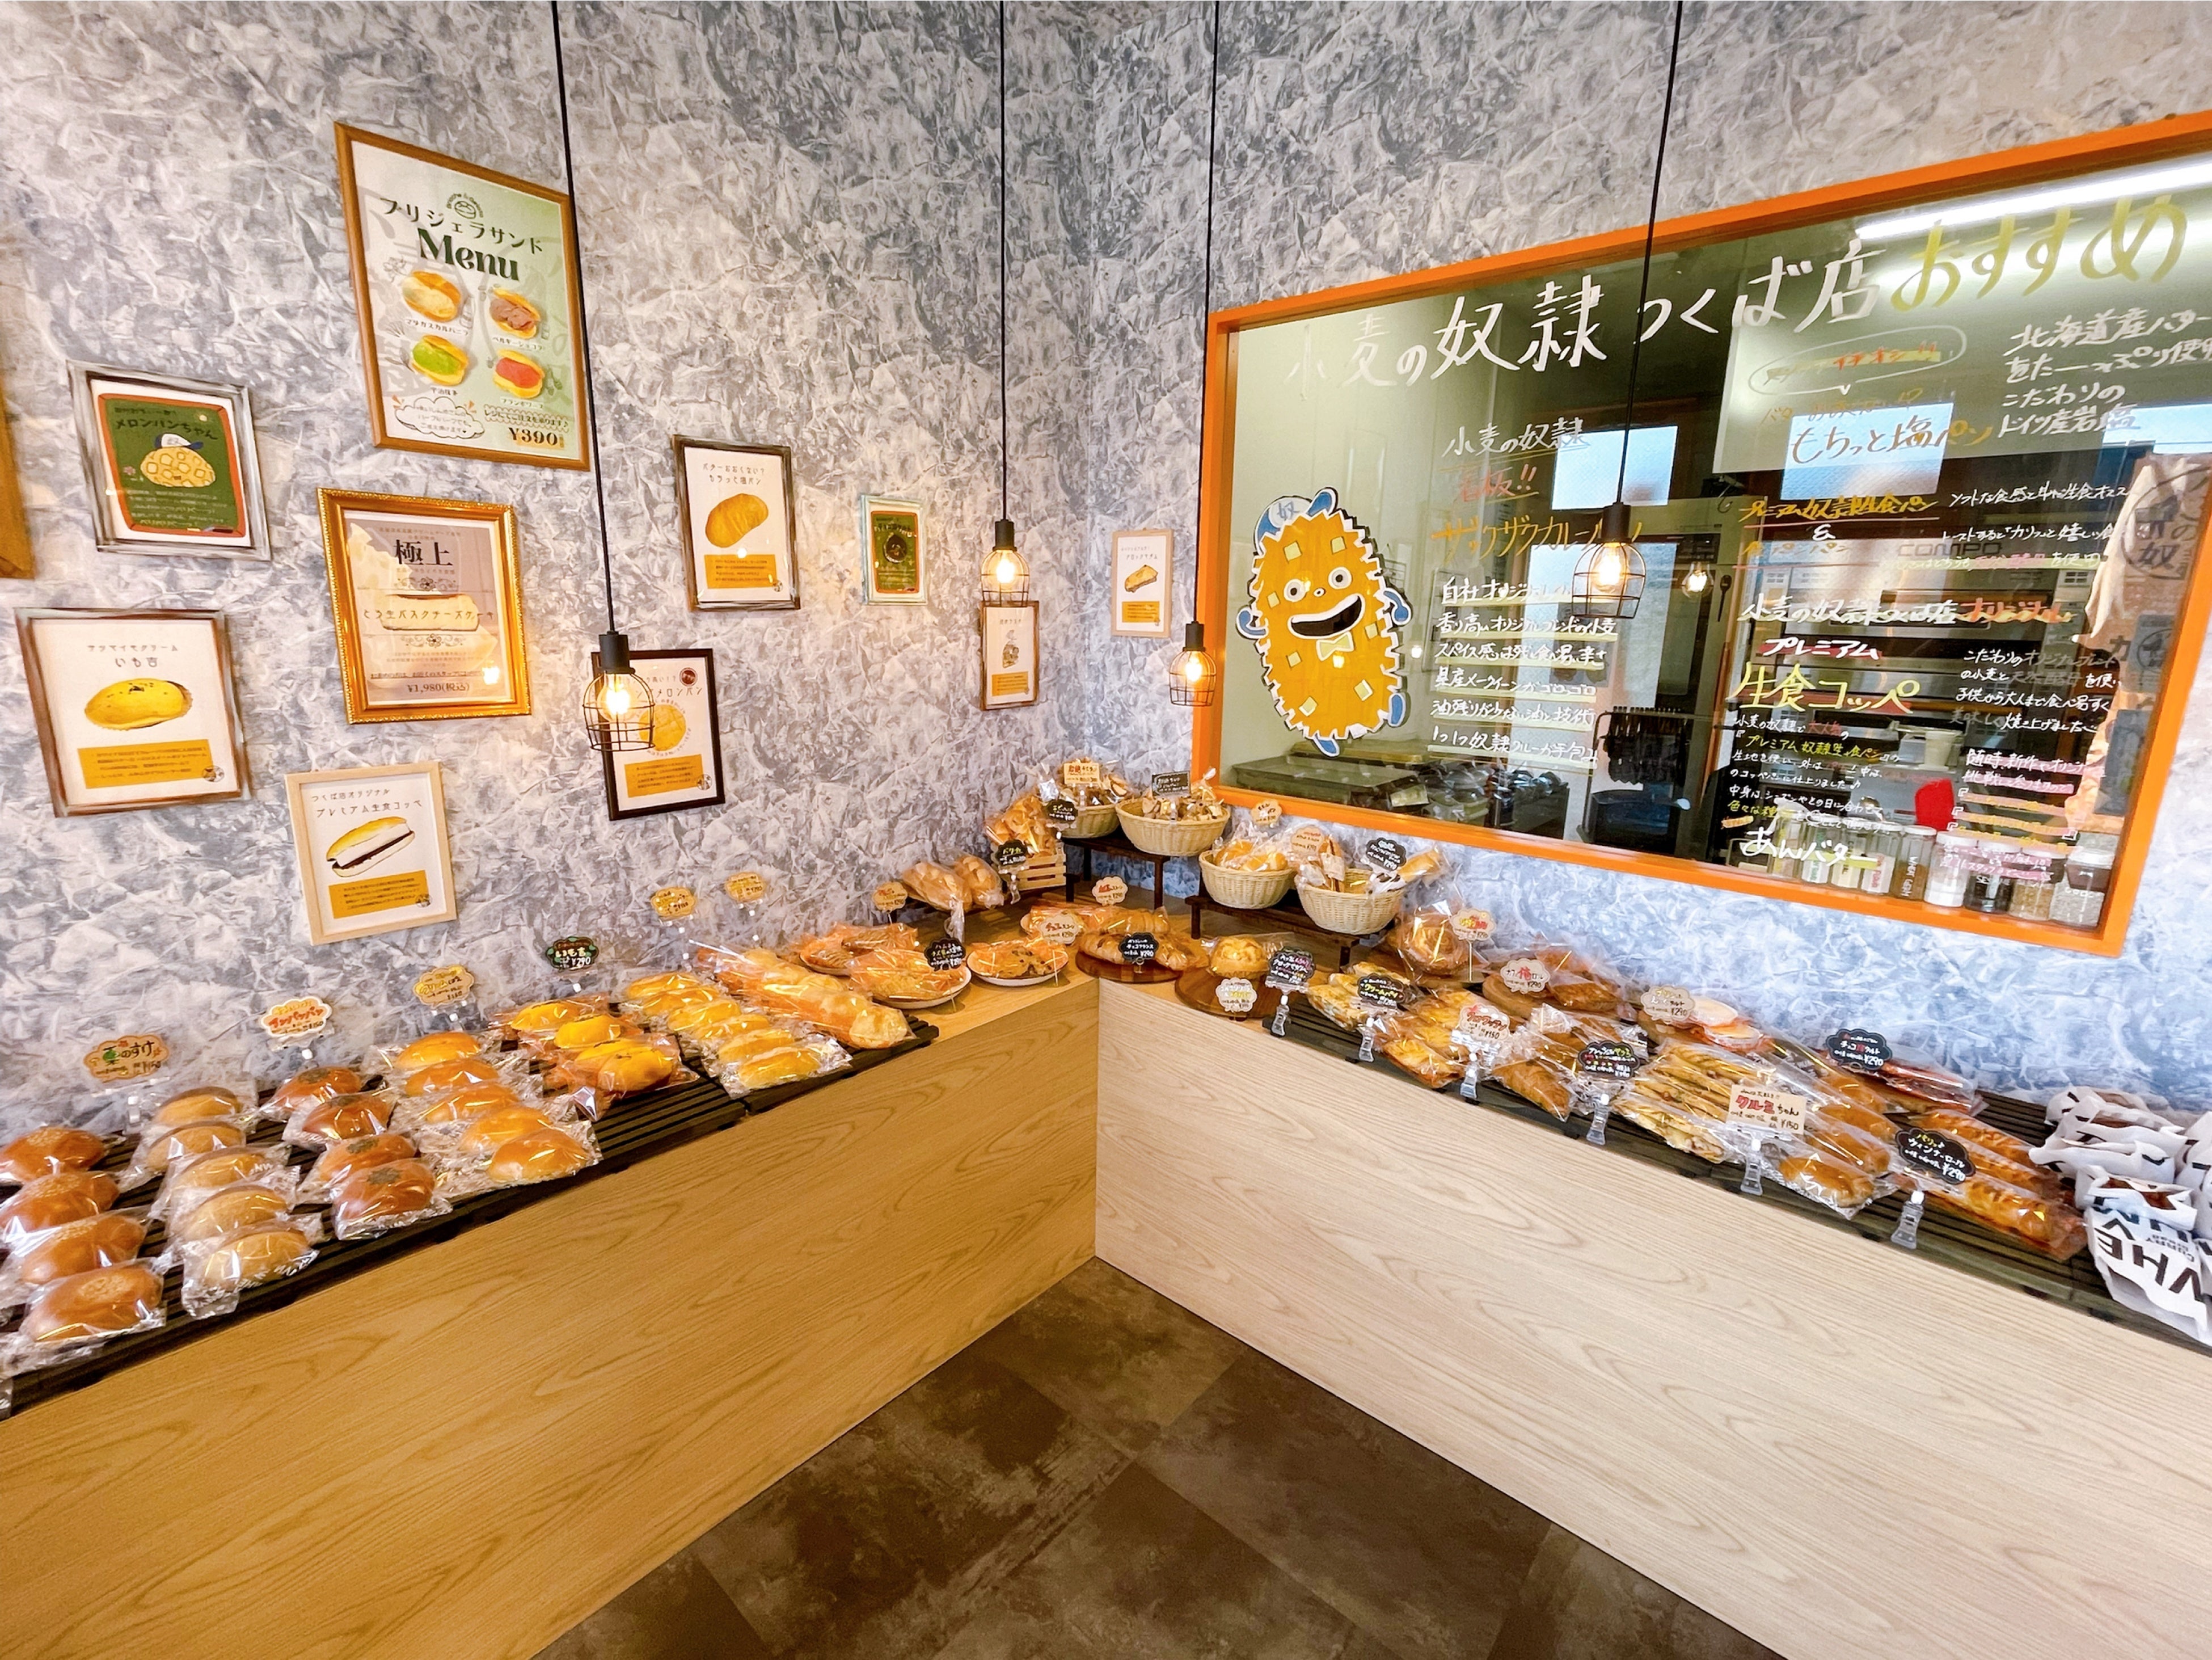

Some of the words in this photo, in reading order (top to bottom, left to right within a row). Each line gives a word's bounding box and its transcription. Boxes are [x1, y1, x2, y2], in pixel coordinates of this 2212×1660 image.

[417, 227, 519, 281] Menu
[1283, 274, 1608, 402] 小麦の奴隷
[1633, 238, 1887, 344] つくば店
[1890, 195, 2188, 311] おすすめ
[2001, 381, 2127, 408] こだわりの
[508, 427, 558, 446] ¥390
[1441, 416, 1592, 457] 小麦の奴隷
[394, 539, 454, 566] 極上
[363, 609, 494, 621] とろ生バスクチーズケーキ
[1724, 661, 1921, 715] 生食コッペ
[311, 788, 390, 803] つくば店オリジナル
[316, 799, 423, 819] プレミアム生食コッペ
[1740, 826, 1878, 866] あんバター
